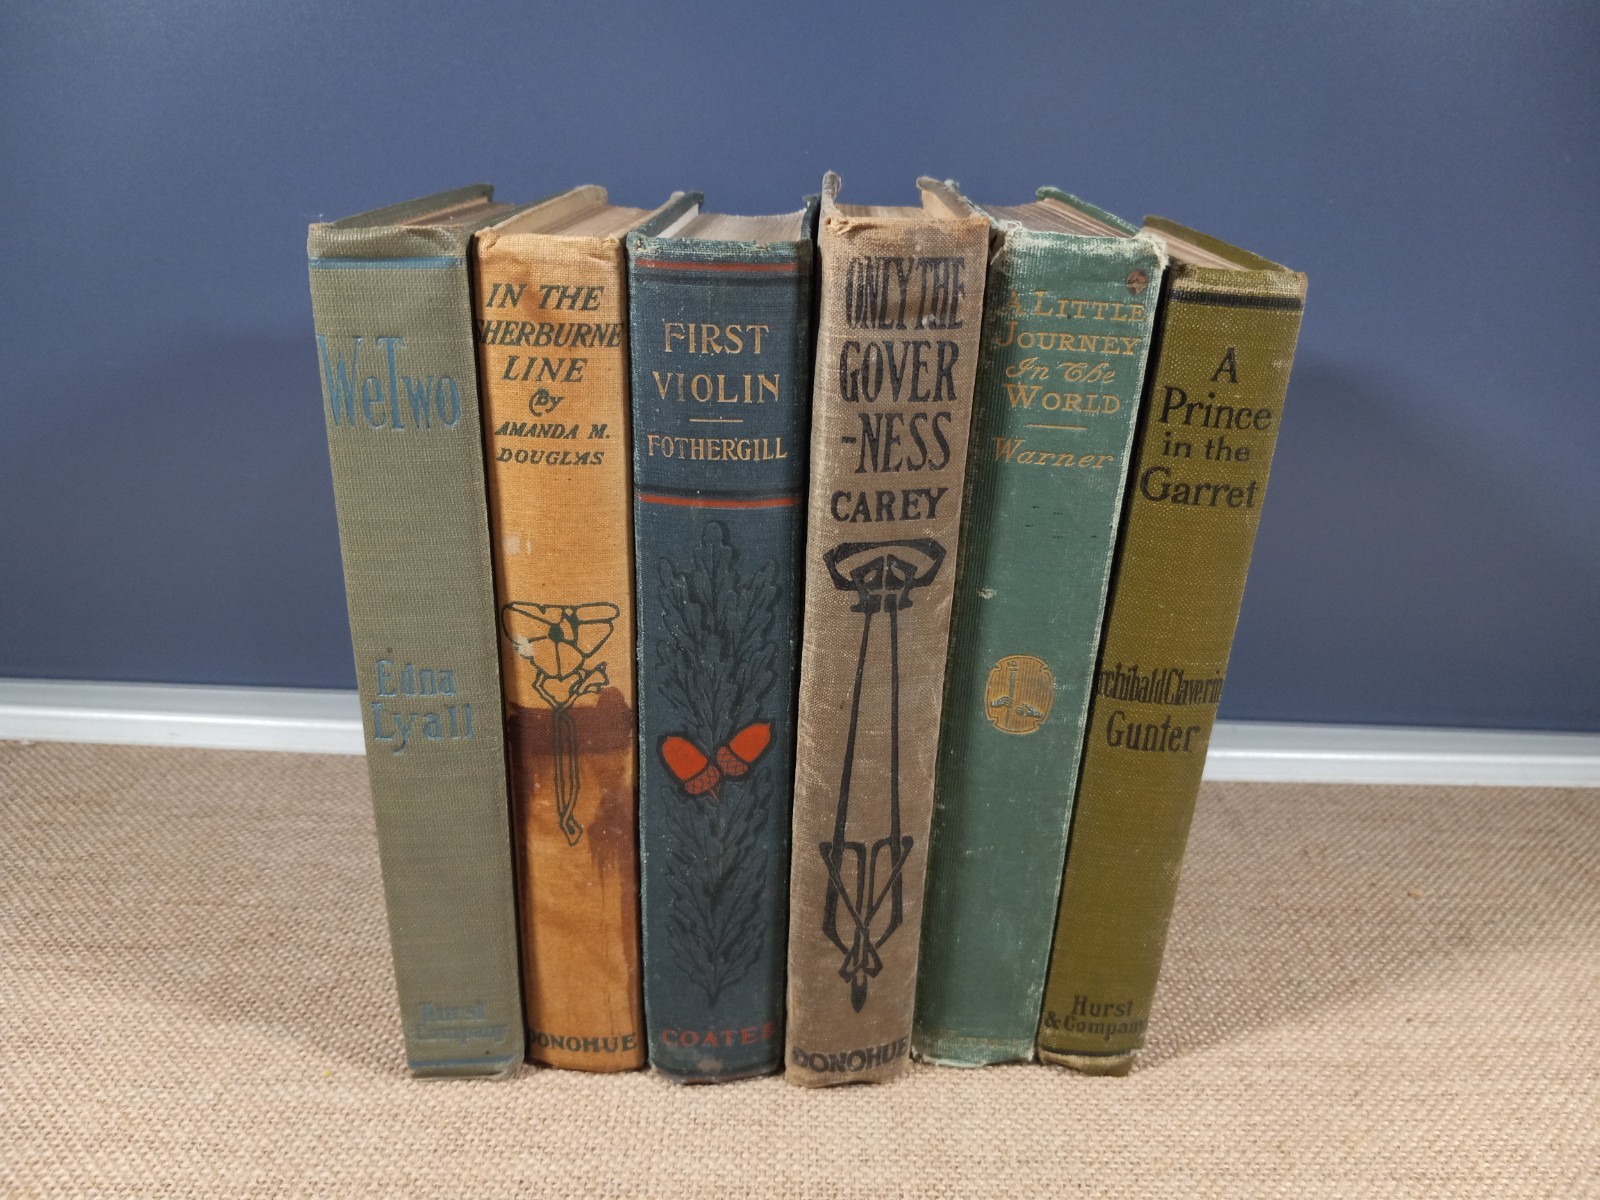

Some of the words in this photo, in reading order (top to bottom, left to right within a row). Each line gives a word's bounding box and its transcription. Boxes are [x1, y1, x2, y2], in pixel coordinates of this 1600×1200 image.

[486, 283, 526, 309] IN
[538, 284, 604, 310] THE
[1003, 288, 1028, 316] A
[1030, 289, 1146, 321] LITTLE
[664, 321, 769, 354] FIRST
[992, 320, 1142, 355] JOURNEY
[502, 355, 588, 383] LINE
[839, 340, 960, 403] GOVER
[1005, 356, 1049, 380] In
[1056, 361, 1116, 384] The
[1211, 347, 1238, 384] A
[529, 387, 564, 417] By
[652, 371, 780, 404] VIOLIN
[1003, 383, 1121, 414] WORLD
[1157, 385, 1272, 431] Prince
[494, 421, 580, 440] AMANDA
[587, 423, 611, 440] M.
[842, 411, 952, 474] -NESS
[1163, 431, 1193, 458] in
[1204, 435, 1250, 463] the
[496, 448, 604, 466] DOUGLAS
[646, 434, 788, 461] FOTHERGILL
[992, 436, 1114, 468] Warner
[1140, 466, 1258, 509] Garret
[830, 487, 949, 523] CAREY
[376, 658, 457, 697] Edna
[1096, 662, 1168, 704] rchibald
[1165, 667, 1223, 706] Claverin
[369, 701, 474, 755] Lyall
[1106, 710, 1200, 753] Gunter
[1044, 1010, 1060, 1030] &
[1071, 995, 1134, 1018] Hurst
[662, 1021, 778, 1047] COATES
[793, 1035, 909, 1073] DONOHUE
